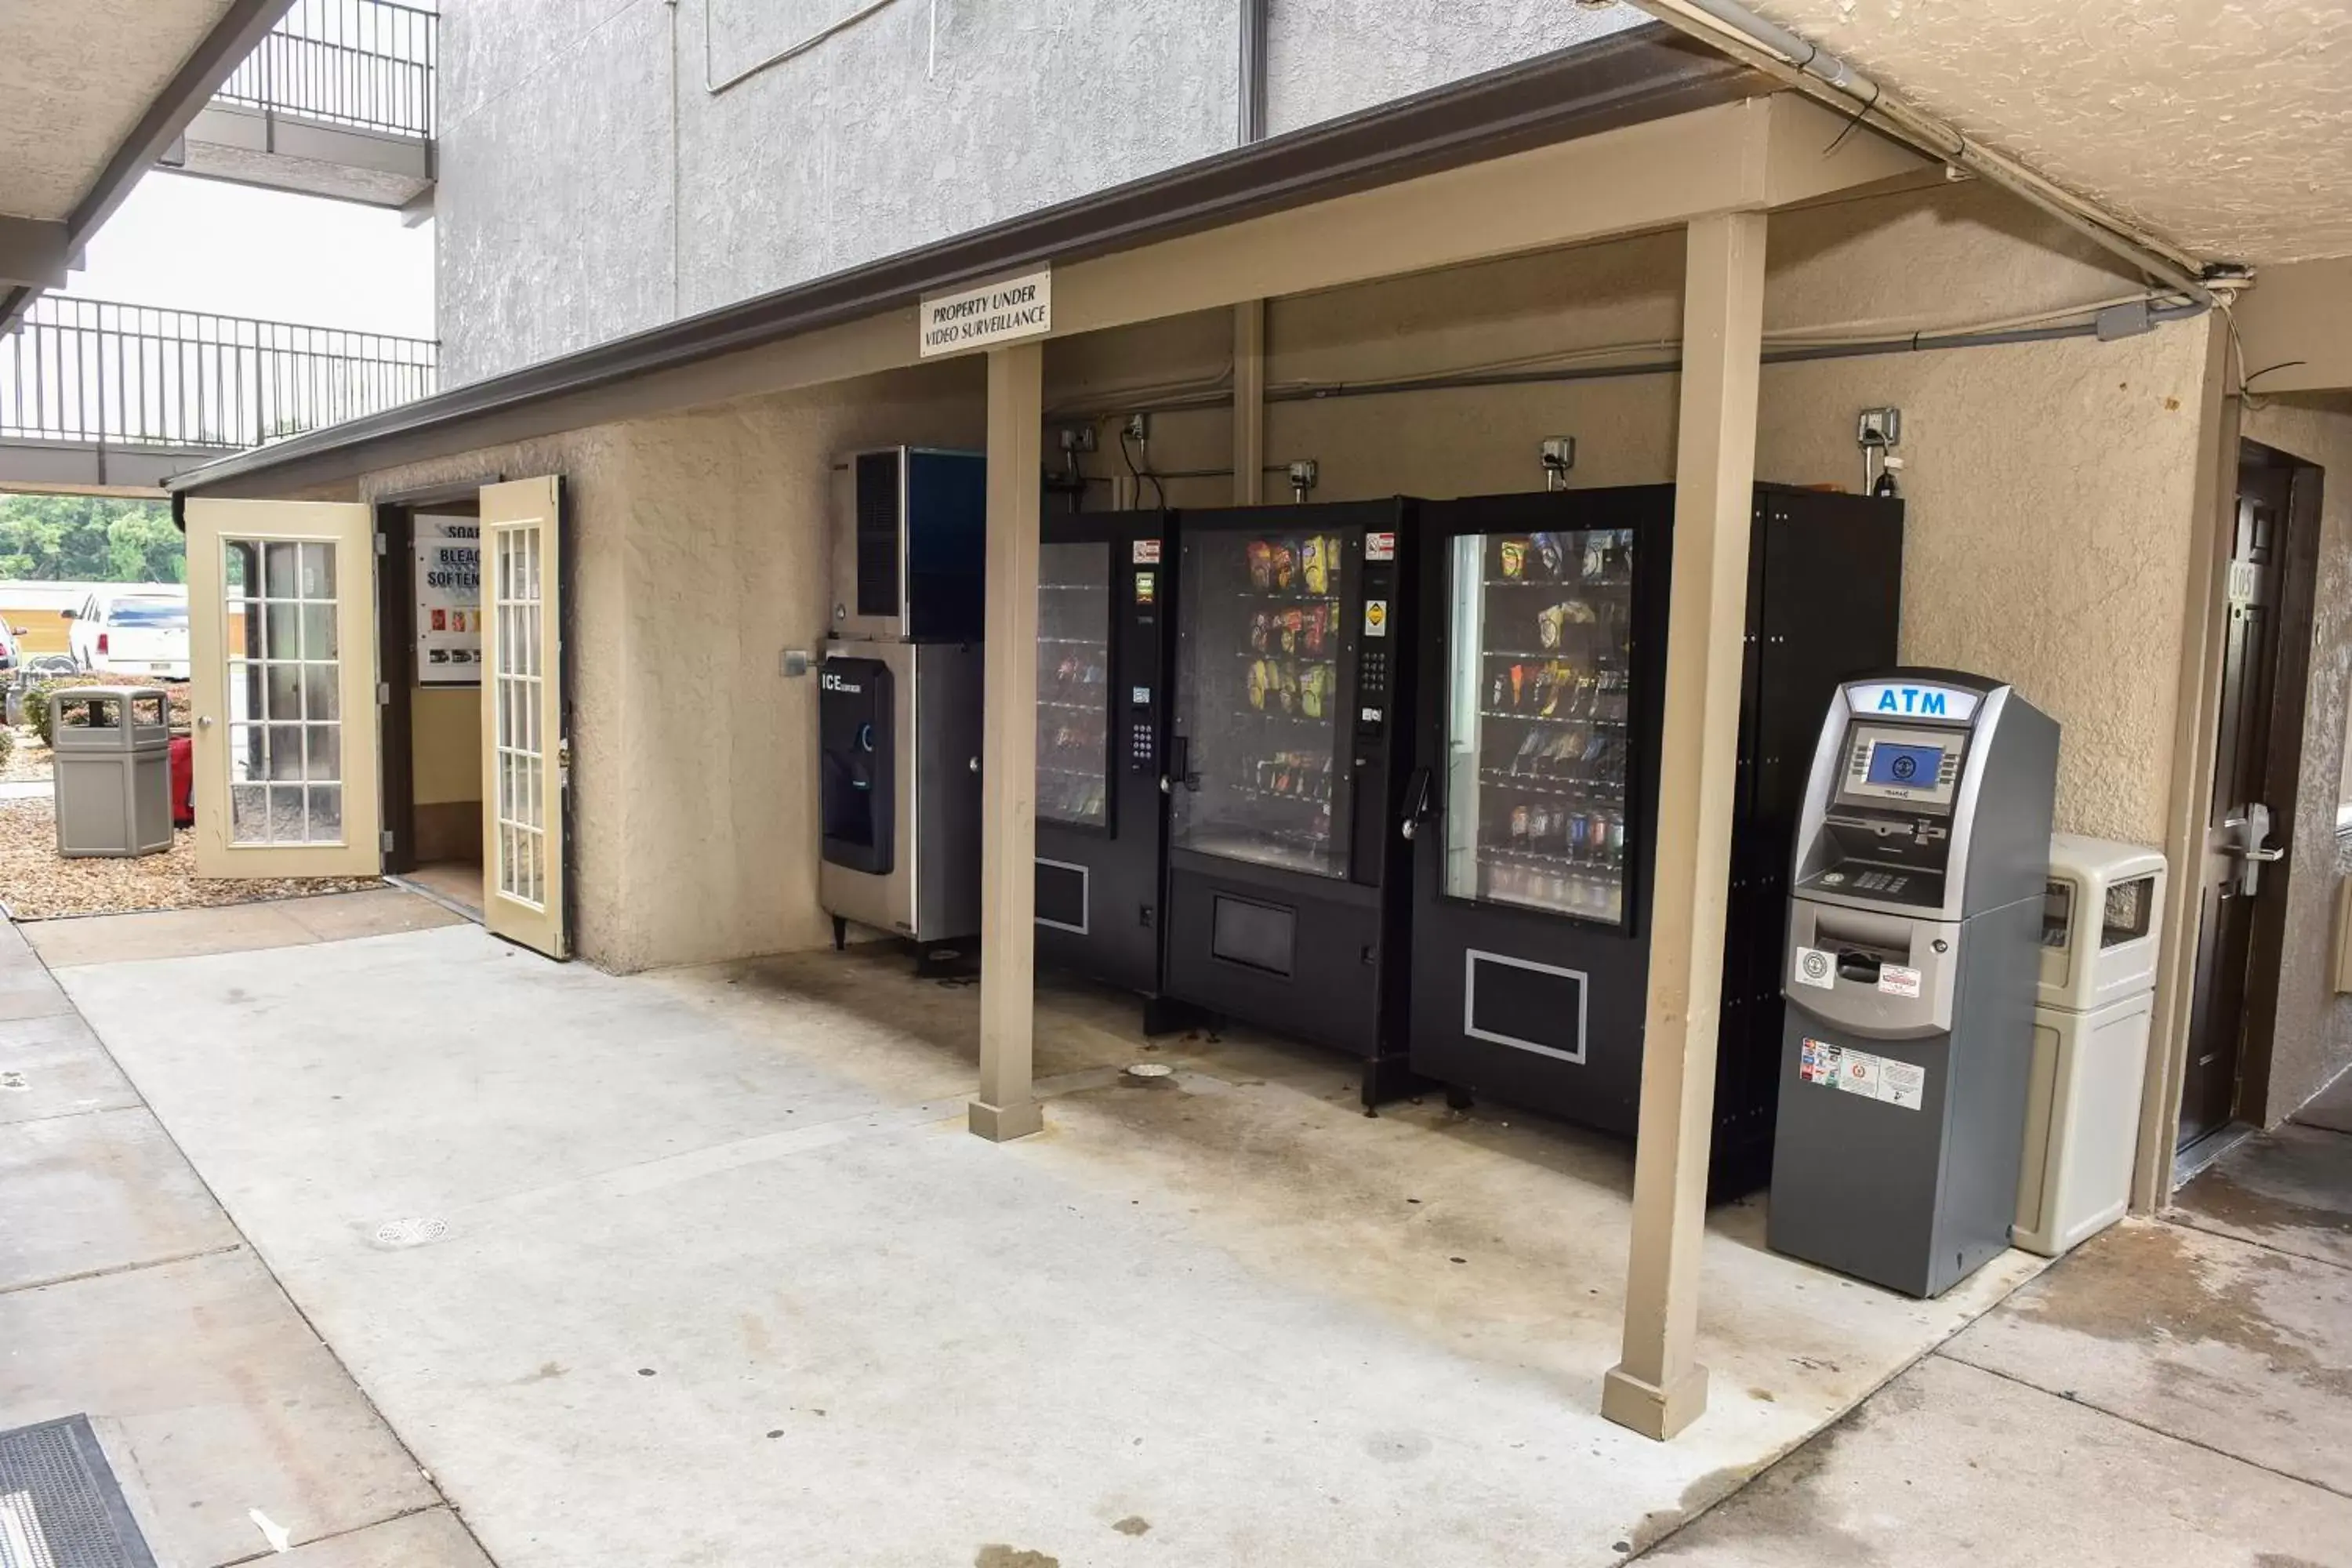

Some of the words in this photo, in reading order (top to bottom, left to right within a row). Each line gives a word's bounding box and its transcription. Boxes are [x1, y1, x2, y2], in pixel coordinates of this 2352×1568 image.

[932, 296, 990, 324] PROPERTY
[993, 285, 1036, 310] UNDER
[926, 326, 959, 346] VIDEO
[962, 305, 1046, 339] SURVEILLANCE
[822, 673, 840, 691] ICE
[1878, 689, 1945, 715] ATM
